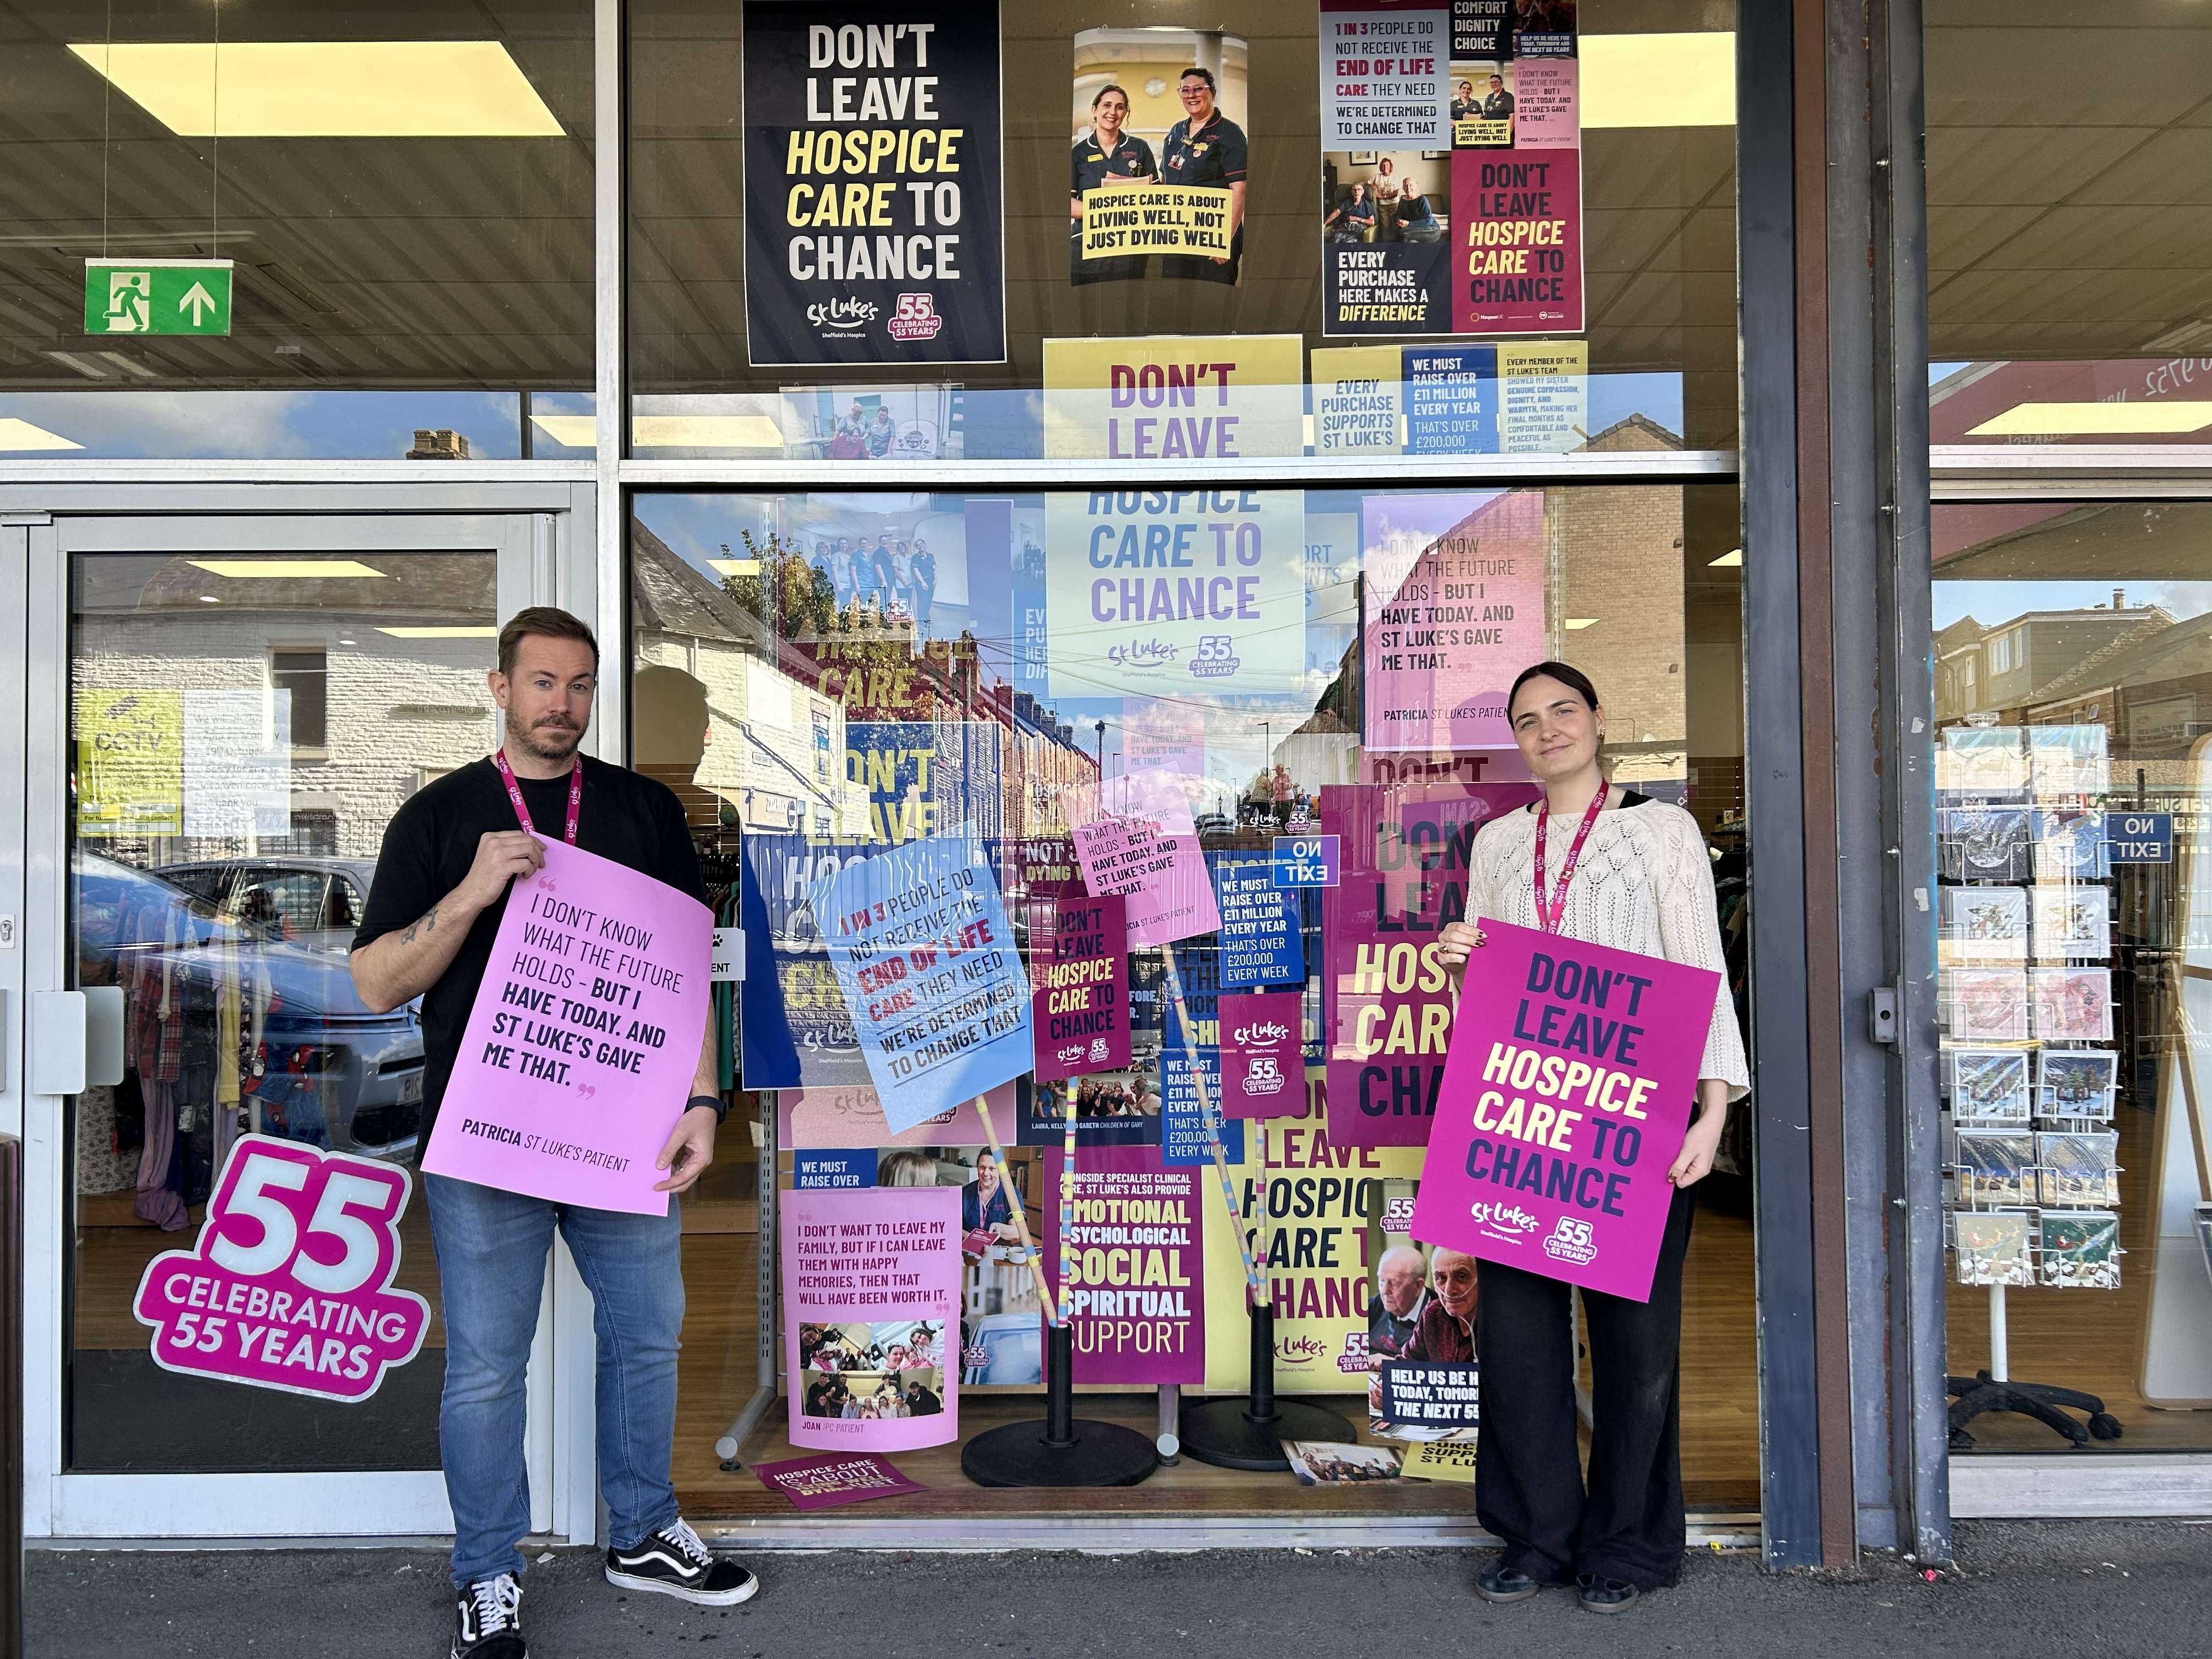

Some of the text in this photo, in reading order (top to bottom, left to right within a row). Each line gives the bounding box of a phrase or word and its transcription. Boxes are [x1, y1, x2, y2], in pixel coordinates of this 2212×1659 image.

[1454, 1, 1507, 14] COMFORT
[1335, 21, 1433, 36] 1 IN 3 PEOPLE DO
[1455, 19, 1500, 32] DIGNITY
[809, 25, 934, 69] DON'T
[1336, 41, 1433, 55] NOT RECEIVE THE
[1455, 37, 1495, 50] CHOICE
[1336, 58, 1434, 76] END OF LIFE
[807, 76, 938, 121] LEAVE
[1336, 83, 1435, 97] CARE THEY NEED
[1336, 105, 1436, 117] WE'RE DETERMINED
[1337, 122, 1436, 134] TO CHANGE THAT
[786, 129, 963, 174] HOSPICE
[1482, 164, 1549, 188] DON'T
[787, 181, 960, 227] CARE TO
[1089, 194, 1226, 210] HOSPICE CARE IS ABOUT
[1480, 193, 1551, 217] LEAVE
[1090, 210, 1224, 229] LIVING WELL, NOT
[1087, 229, 1226, 250] JUST DYING WELL
[1469, 220, 1566, 246] HOSPICE
[789, 235, 960, 280] CHANCE
[1339, 252, 1386, 268] EVERY
[1469, 250, 1563, 275] CARE TO
[1339, 270, 1415, 286] PURCHASE
[1339, 289, 1428, 303] HERE MAKES A
[1471, 278, 1564, 303] CHANCE
[899, 296, 932, 319] 55
[1339, 305, 1426, 321] DIFFERENCE
[892, 319, 938, 329] CELEBRATING
[908, 326, 933, 335] YEARS
[1110, 363, 1235, 408] DON'T
[1335, 379, 1379, 394] EVERY
[1322, 396, 1393, 413] PURCHASE
[1323, 414, 1393, 431] SUPPORTS
[1323, 431, 1392, 448] ST LUKE'S
[1088, 522, 1261, 569] CARE TO
[1091, 576, 1260, 622] CHANCE
[1222, 878, 1268, 893] WE MUST
[1222, 891, 1282, 906] RAISE OVER
[531, 893, 653, 951] I DON'T KNOW
[1224, 906, 1282, 921] £11 MILLION
[1224, 920, 1286, 935] EVERY YEAR
[1226, 938, 1285, 952] THAT'S OVER
[524, 922, 684, 994] WHAT THE FUTURE
[1228, 953, 1273, 967] £200,000
[512, 951, 575, 989] HOLDS
[591, 977, 631, 1006] BUT
[633, 990, 641, 1010] I
[1228, 966, 1288, 981] EVERY WEEK
[1526, 952, 1651, 1017] DON'T
[501, 981, 666, 1049] HAVE TODAY. AND
[1513, 998, 1644, 1068] LEAVE
[492, 1012, 645, 1074] ST LUKE'S GAVE
[481, 1042, 571, 1087] ME THAT.
[1250, 1060, 1276, 1079] 55
[1244, 1077, 1283, 1086] CELEBRATING
[1482, 1042, 1658, 1120] HOSPICE
[1472, 1091, 1641, 1167] CARE TO
[461, 1118, 630, 1173] PATRICIA ST LUKE'S PATIENT
[1465, 1138, 1631, 1217] CHANCE
[209, 1153, 392, 1293] 55
[798, 1221, 945, 1237] I DON'T WANT TO LEAVE MY
[1557, 1219, 1590, 1245] 55
[798, 1238, 945, 1256] FAMILY, BUT IF I CAN LEAVE
[1548, 1239, 1594, 1257] CELEBRATING
[1549, 1246, 1587, 1262] 55 YEARS
[798, 1257, 898, 1271] THEM WITH HAPPY
[798, 1273, 920, 1289] MEMORIES, THEN THAT
[799, 1289, 947, 1305] WILL HAVE BEEN WORTH IT.
[164, 1273, 407, 1342] CELEBRATING
[170, 1313, 373, 1379] 55 YEARS
[802, 1421, 864, 1434] JOAN IPC PATIENT
